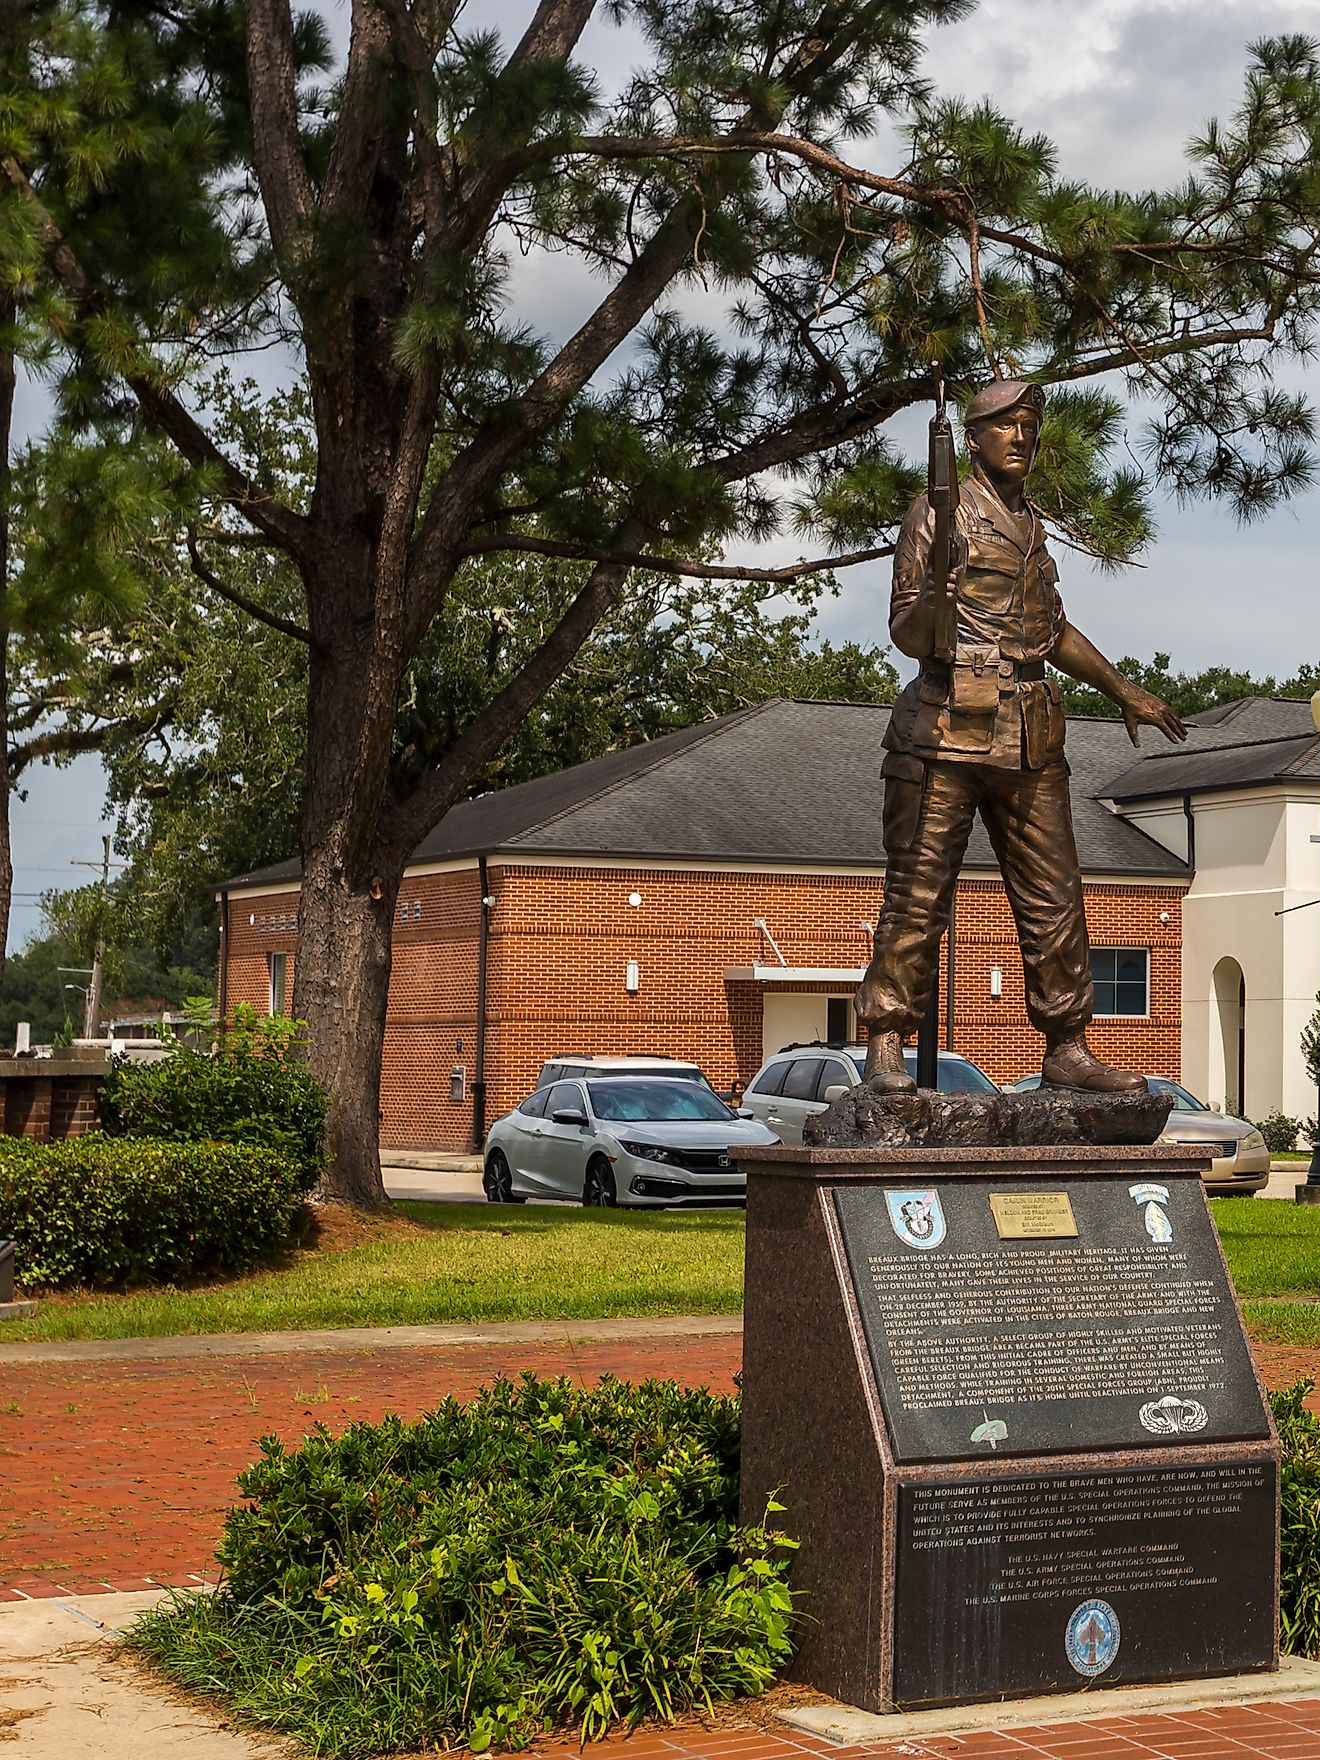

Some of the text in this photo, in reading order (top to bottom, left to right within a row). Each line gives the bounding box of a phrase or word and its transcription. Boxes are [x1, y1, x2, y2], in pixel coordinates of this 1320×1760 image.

[952, 1290, 993, 1298] GENEROUS
[994, 1287, 1050, 1296] CONTRIBUTION
[1150, 1281, 1192, 1289] CONTINUED
[881, 1311, 917, 1319] CONSENT
[883, 1319, 939, 1328] DETACHMENTS
[962, 1316, 1003, 1324] ACTIVATED
[889, 1349, 912, 1357] FROM
[929, 1346, 960, 1354] BREAUX
[896, 1375, 930, 1383] CAPABLE
[931, 1373, 956, 1381] FORCE
[958, 1371, 998, 1379] QUALIFIED
[1032, 1366, 1069, 1374] CONDUCT
[1083, 1363, 1117, 1371] WARFARE
[1129, 1358, 1196, 1368] UNCONVENTIONAL
[914, 1490, 932, 1498] THIS
[934, 1486, 979, 1497] MONUMENT
[992, 1482, 1036, 1493] DEDICATED
[1039, 1481, 1049, 1489] TO
[1052, 1480, 1066, 1488] THE
[1069, 1478, 1094, 1487] BRAVE
[1096, 1477, 1113, 1485] MEN
[1115, 1475, 1134, 1483] WHO
[1160, 1472, 1175, 1480] ARE
[1200, 1469, 1216, 1477] AND
[1218, 1468, 1234, 1476] WILL
[1247, 1466, 1261, 1474] THE
[912, 1502, 945, 1511] FUTURE
[948, 1499, 973, 1508] SERVE
[976, 1498, 987, 1506] AS
[989, 1495, 1027, 1505] MEMBERS
[1044, 1493, 1058, 1501] THE
[1078, 1489, 1108, 1499] SPECIAL
[1112, 1486, 1160, 1496] OPERATIONS
[1206, 1481, 1219, 1489] THE
[1221, 1479, 1252, 1488] MISSION
[913, 1492, 1242, 1524] WHICH IS TO PROVIDE FULLY CAPABLE SPECIAL OPERATIONS FORCES TO DEFEND THE
[912, 1527, 942, 1537] UNITED
[944, 1525, 974, 1534] STATES
[976, 1523, 994, 1532] AND
[995, 1522, 1008, 1530] ITS
[1010, 1519, 1053, 1529] INTERESTS
[1056, 1517, 1072, 1525] AND
[1075, 1516, 1086, 1524] TO
[1088, 1512, 1141, 1523] SYNCHRONIZE
[1196, 1506, 1209, 1514] THE
[912, 1538, 963, 1549] OPERATIONS
[966, 1535, 1001, 1545] AGAINST
[1005, 1532, 1047, 1542] TERRORIST
[1008, 1555, 1022, 1563] THE
[1042, 1552, 1063, 1560] NAVY
[1066, 1549, 1097, 1558] SPECIAL
[1101, 1546, 1137, 1555] WARFARE
[1139, 1542, 1178, 1552] COMMAND
[1000, 1568, 1015, 1576] THE
[1035, 1564, 1058, 1573] ARMY
[1060, 1562, 1091, 1571] SPECIAL
[1095, 1557, 1144, 1568] OPERATIONS
[1145, 1554, 1184, 1564] COMMAND
[988, 1582, 1005, 1590] THE
[1025, 1579, 1039, 1587] AIR
[1041, 1576, 1067, 1586] FORCE
[1070, 1574, 1101, 1583] SPECIAL
[1104, 1569, 1153, 1580] OPERATIONS
[1155, 1566, 1194, 1576] COMMAND
[964, 1596, 979, 1605] THE
[999, 1592, 1029, 1602] MARINE
[1031, 1590, 1059, 1599] CORPS
[1061, 1587, 1092, 1596] FORCES
[1095, 1584, 1126, 1593] SPECIAL
[1129, 1579, 1176, 1590] OPERATIONS
[1178, 1576, 1217, 1586] COMMAND
